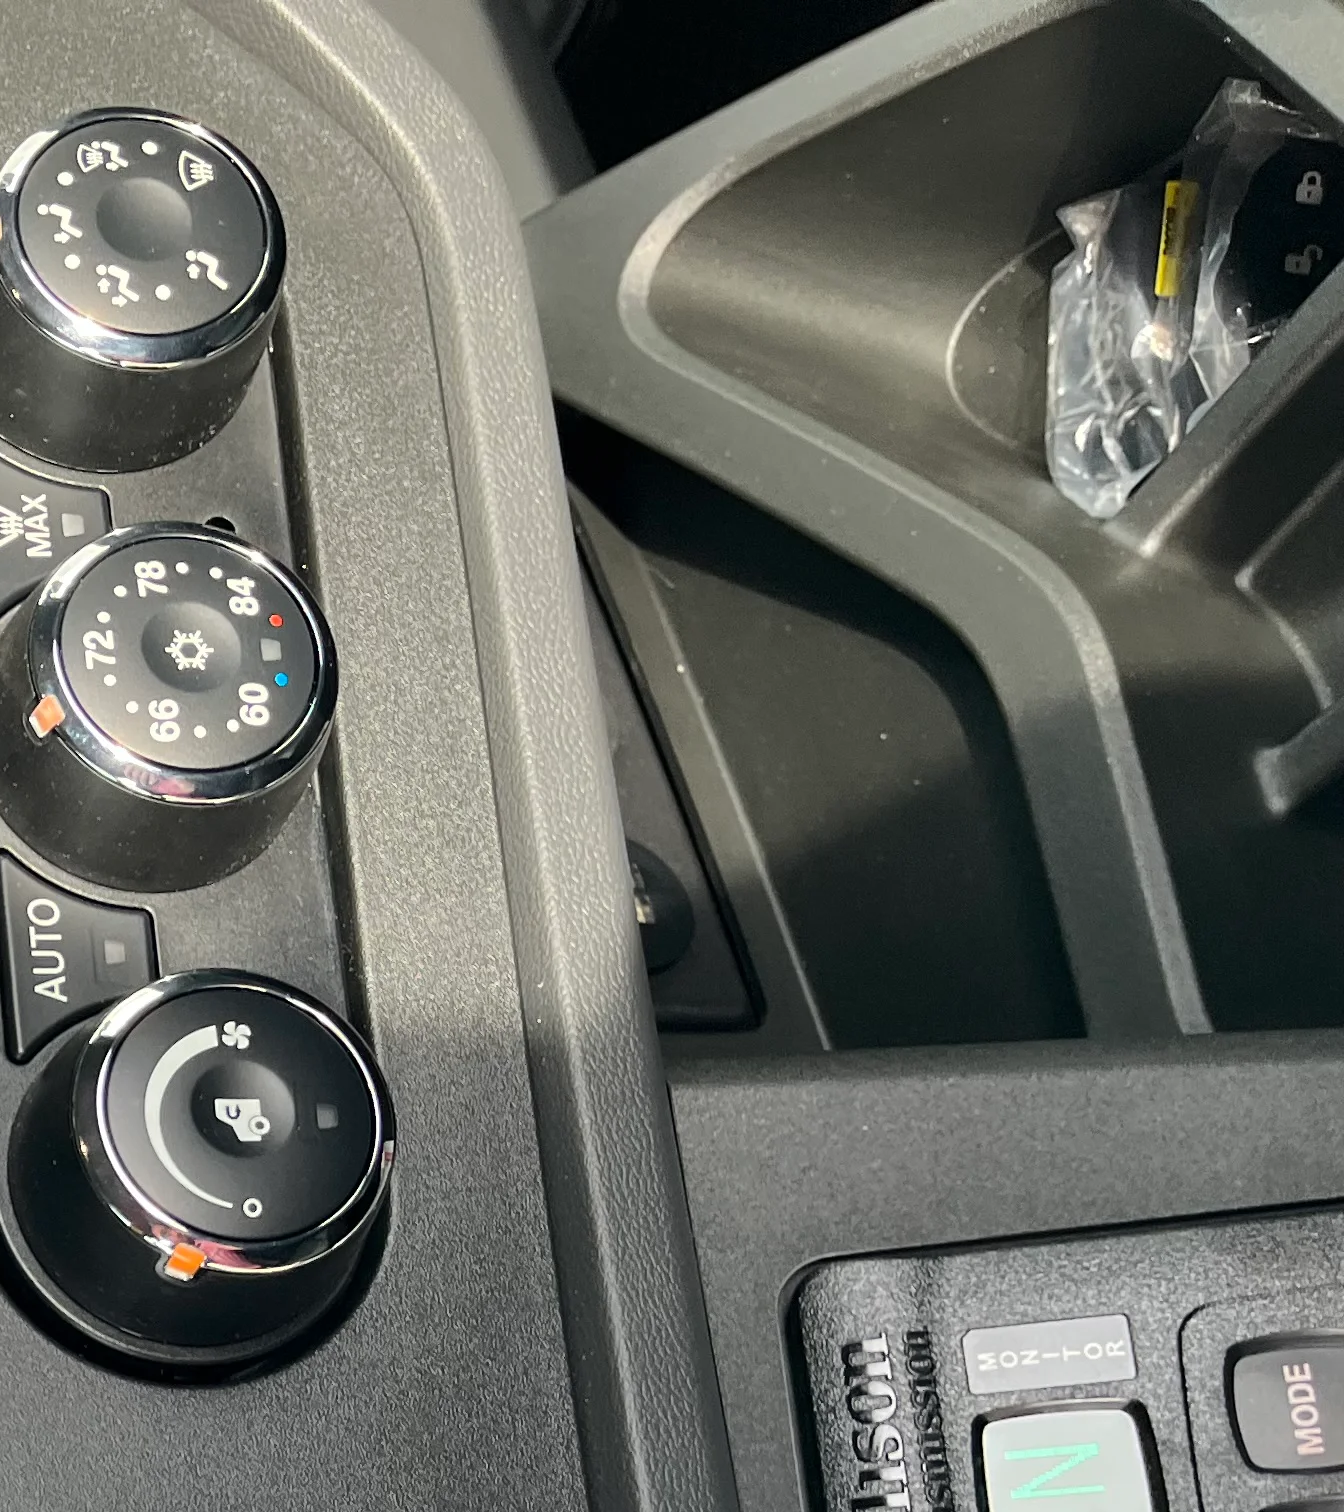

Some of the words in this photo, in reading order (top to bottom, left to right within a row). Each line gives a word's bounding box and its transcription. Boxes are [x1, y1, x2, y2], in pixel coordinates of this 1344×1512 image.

[20, 493, 53, 558] MAX
[134, 559, 169, 597] 78
[226, 575, 261, 617] 84
[82, 628, 117, 671] 72
[148, 697, 181, 742] 66
[238, 681, 271, 727] 60
[26, 897, 68, 1004] AUTO
[977, 1336, 1129, 1372] MONITOR
[1282, 1361, 1326, 1457] MODE
